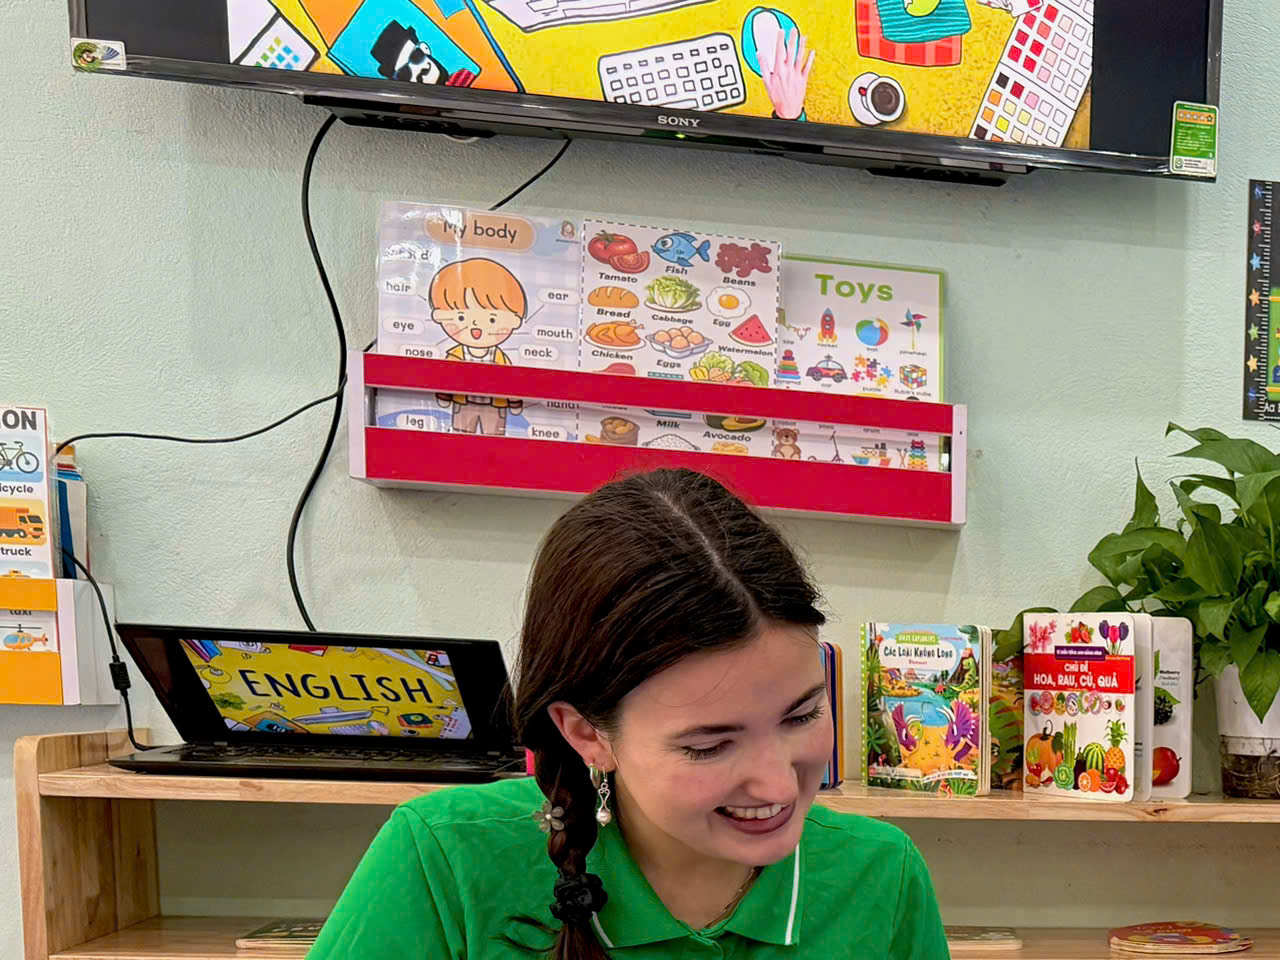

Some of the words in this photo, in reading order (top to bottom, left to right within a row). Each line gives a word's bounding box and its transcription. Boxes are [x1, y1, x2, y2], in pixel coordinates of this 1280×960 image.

[657, 115, 701, 128] SONY
[473, 219, 518, 244] body
[665, 265, 689, 276] Fish
[385, 281, 412, 294] hair
[722, 276, 757, 288] Beans
[814, 273, 895, 304] Toys
[547, 291, 569, 301] ear
[595, 307, 632, 319] Bread
[651, 313, 695, 326] Cabbage
[392, 321, 416, 332] eye
[712, 317, 732, 329] Egg
[536, 327, 574, 340] mouth
[404, 347, 434, 358] nose
[523, 346, 553, 359] neck
[591, 349, 634, 362] Chicken
[717, 344, 774, 358] Watermelon
[656, 358, 682, 370] Eggs
[1264, 403, 1275, 412] Aa
[404, 415, 425, 429] leg
[655, 419, 681, 430] Milk
[531, 426, 560, 440] knee
[702, 431, 752, 443] Avocado
[1, 546, 32, 557] truck
[238, 669, 434, 704] ENGLISH
[1033, 673, 1056, 688] HOA,
[1058, 674, 1078, 689] RAU,
[1097, 671, 1119, 688] QUẢ
